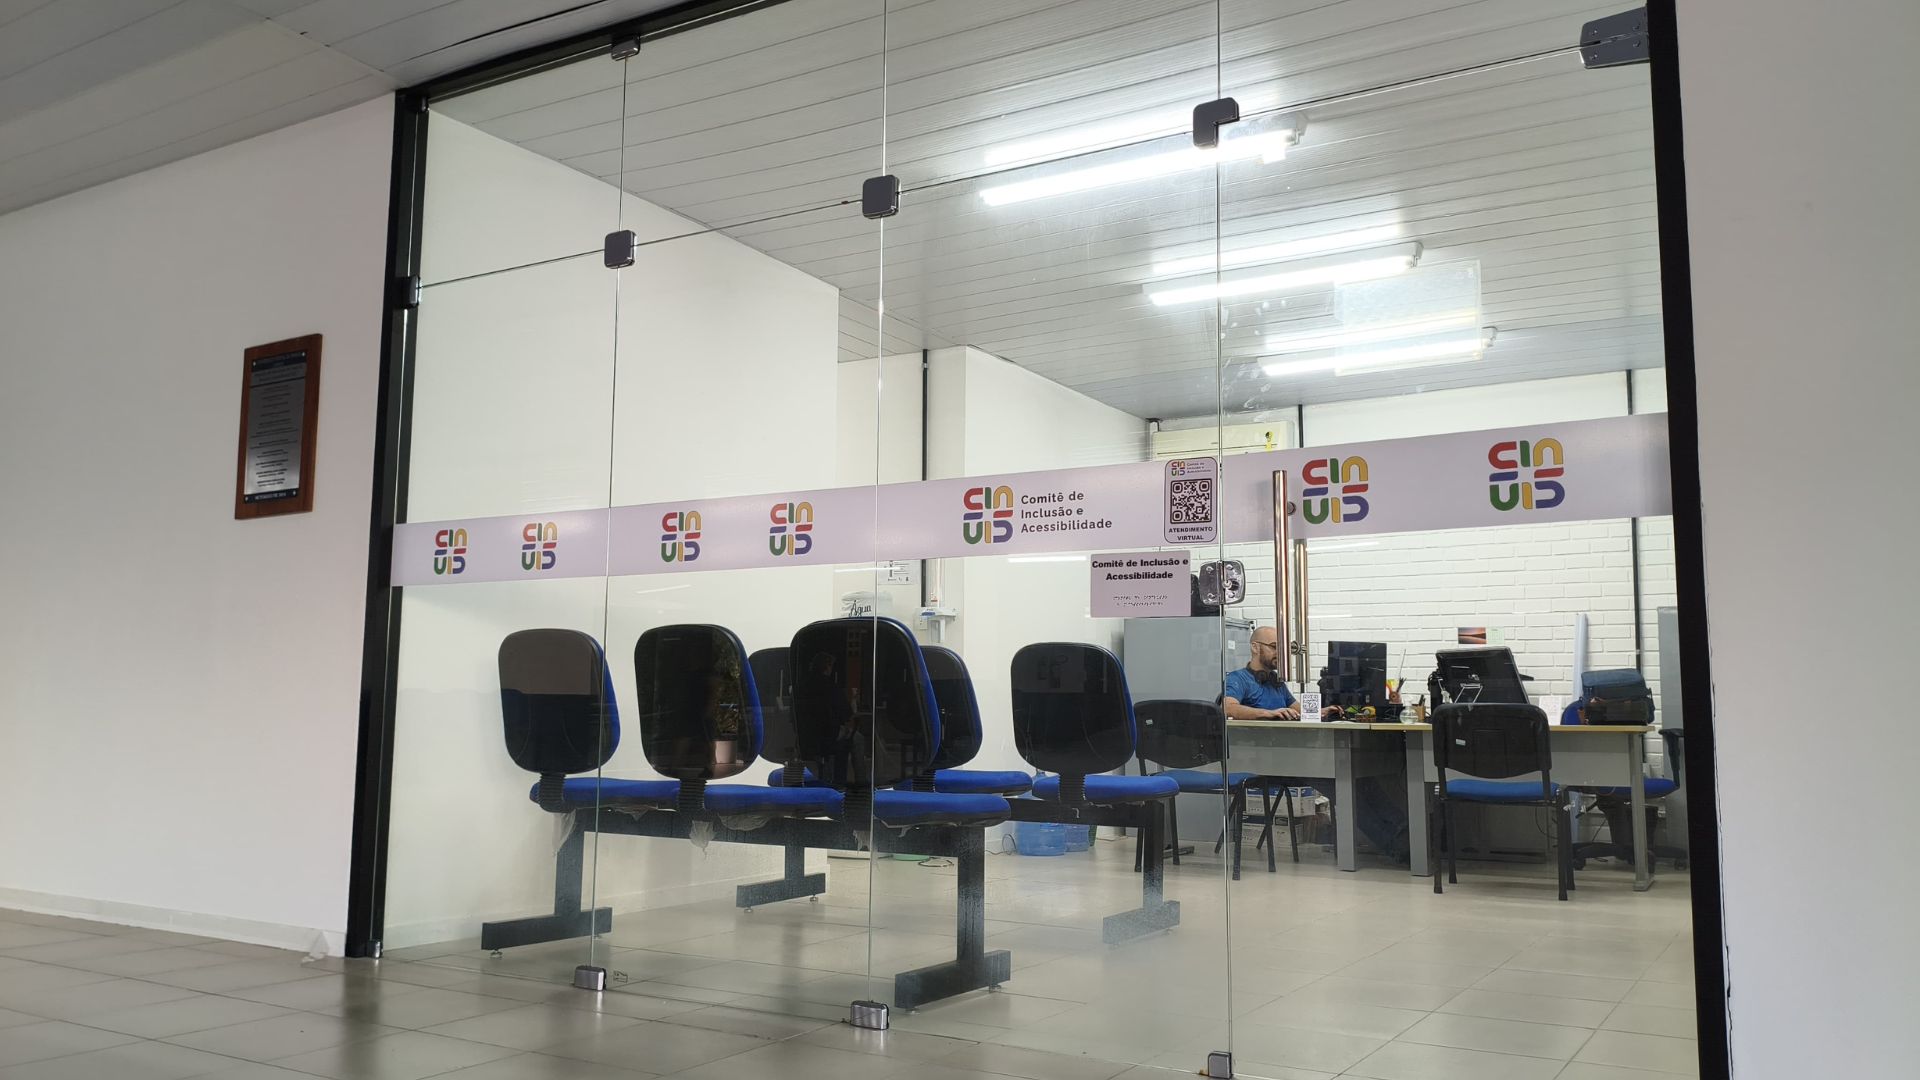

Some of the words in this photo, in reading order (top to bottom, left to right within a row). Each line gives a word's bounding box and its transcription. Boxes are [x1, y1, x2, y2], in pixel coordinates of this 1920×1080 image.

[1021, 492, 1064, 505] Comitê
[1068, 491, 1084, 501] de
[1021, 506, 1073, 519] Inclusão
[1076, 507, 1083, 515] e
[1021, 518, 1112, 533] Acessibilidade
[1092, 560, 1124, 568] Comitê
[1126, 559, 1138, 567] de
[1140, 558, 1180, 567] Inclusão
[1106, 571, 1174, 581] Acessibilidade
